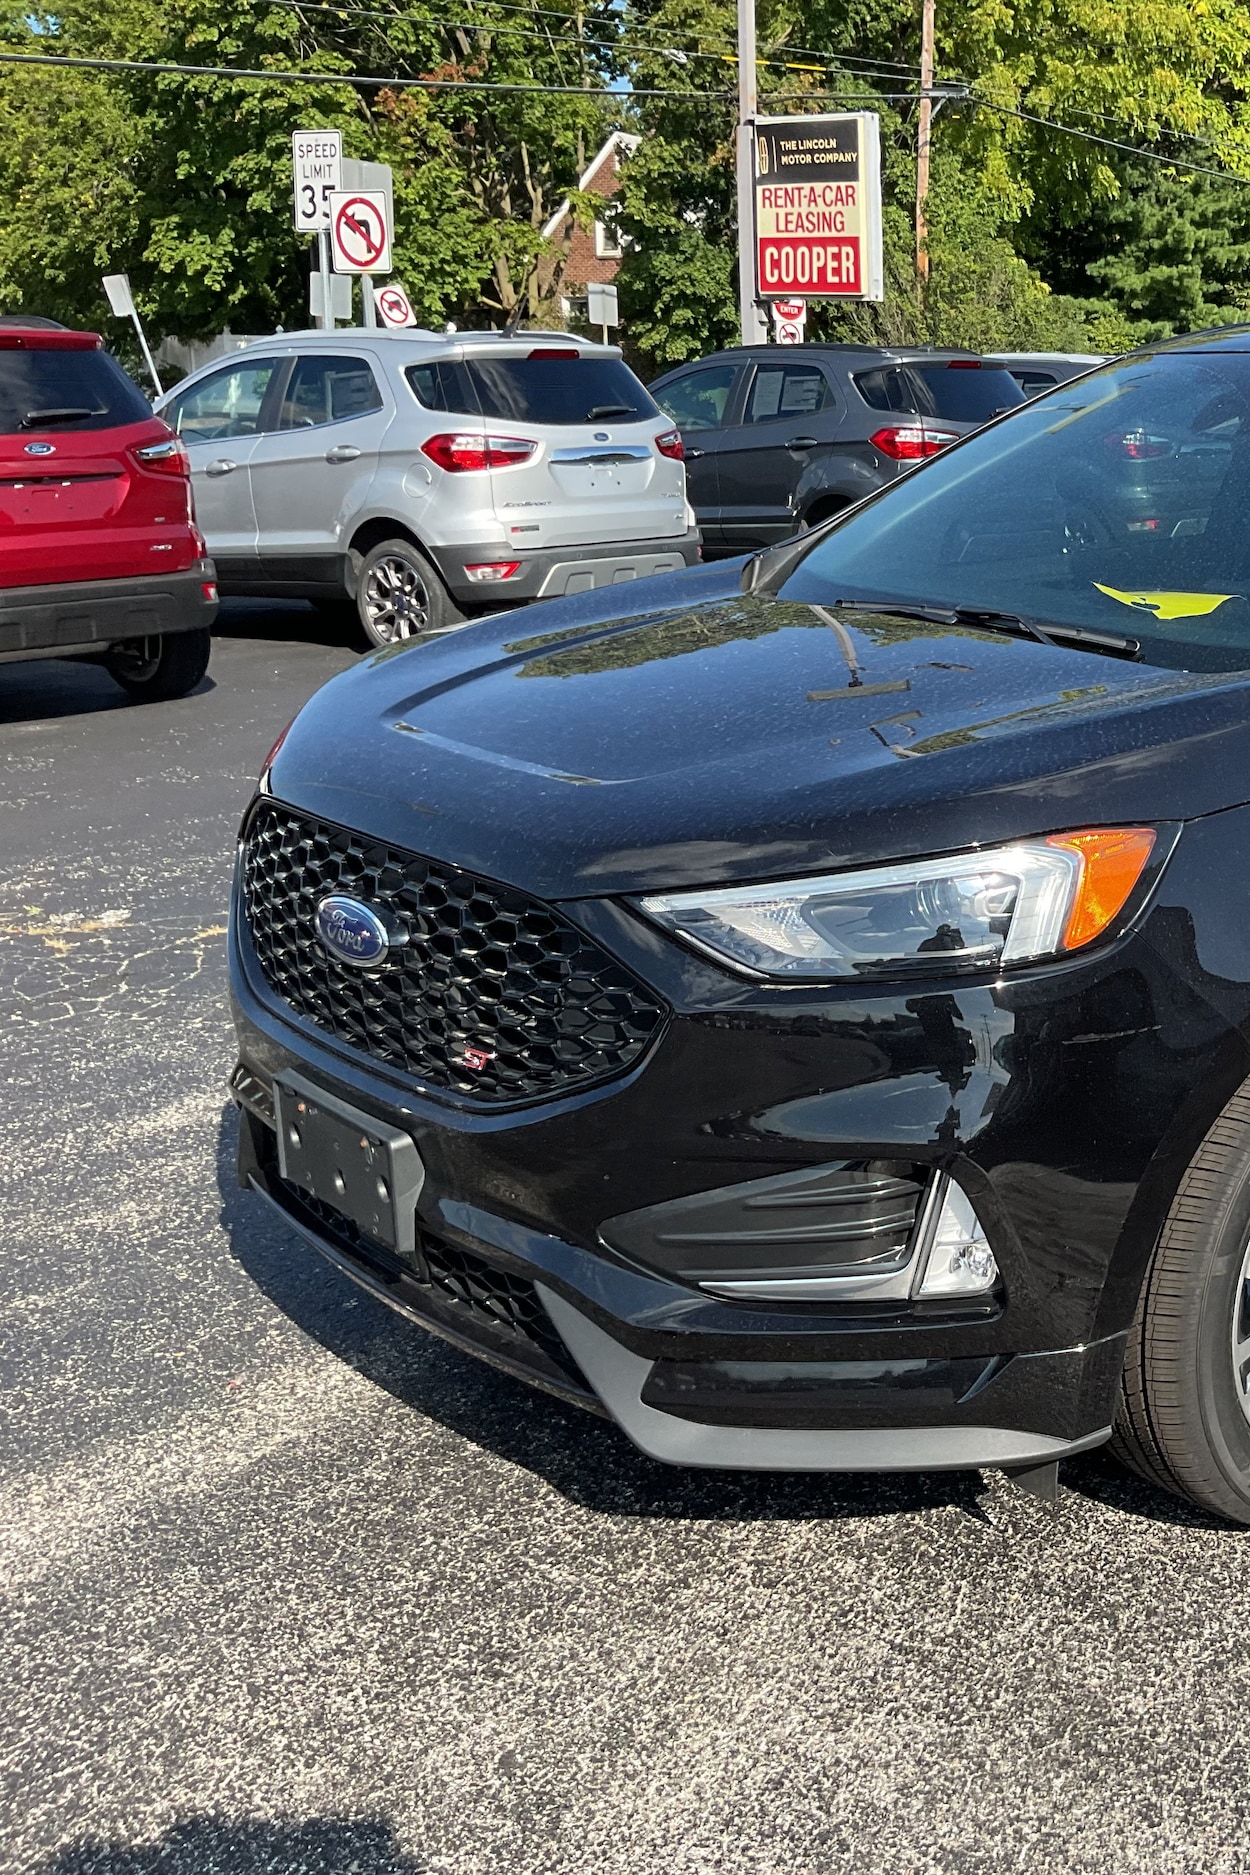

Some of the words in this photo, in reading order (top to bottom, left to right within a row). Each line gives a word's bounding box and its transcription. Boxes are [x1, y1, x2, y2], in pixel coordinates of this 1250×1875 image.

[298, 143, 337, 158] SPEED
[780, 141, 797, 151] THE
[799, 138, 837, 149] LINCOLN
[781, 154, 812, 165] MOTOR
[814, 152, 857, 164] COMPANY
[303, 164, 333, 179] LIMIT
[762, 185, 856, 208] RENT-A-CAR
[776, 211, 845, 233] LEASING
[765, 246, 855, 284] COOPER
[780, 305, 799, 315] ENTER
